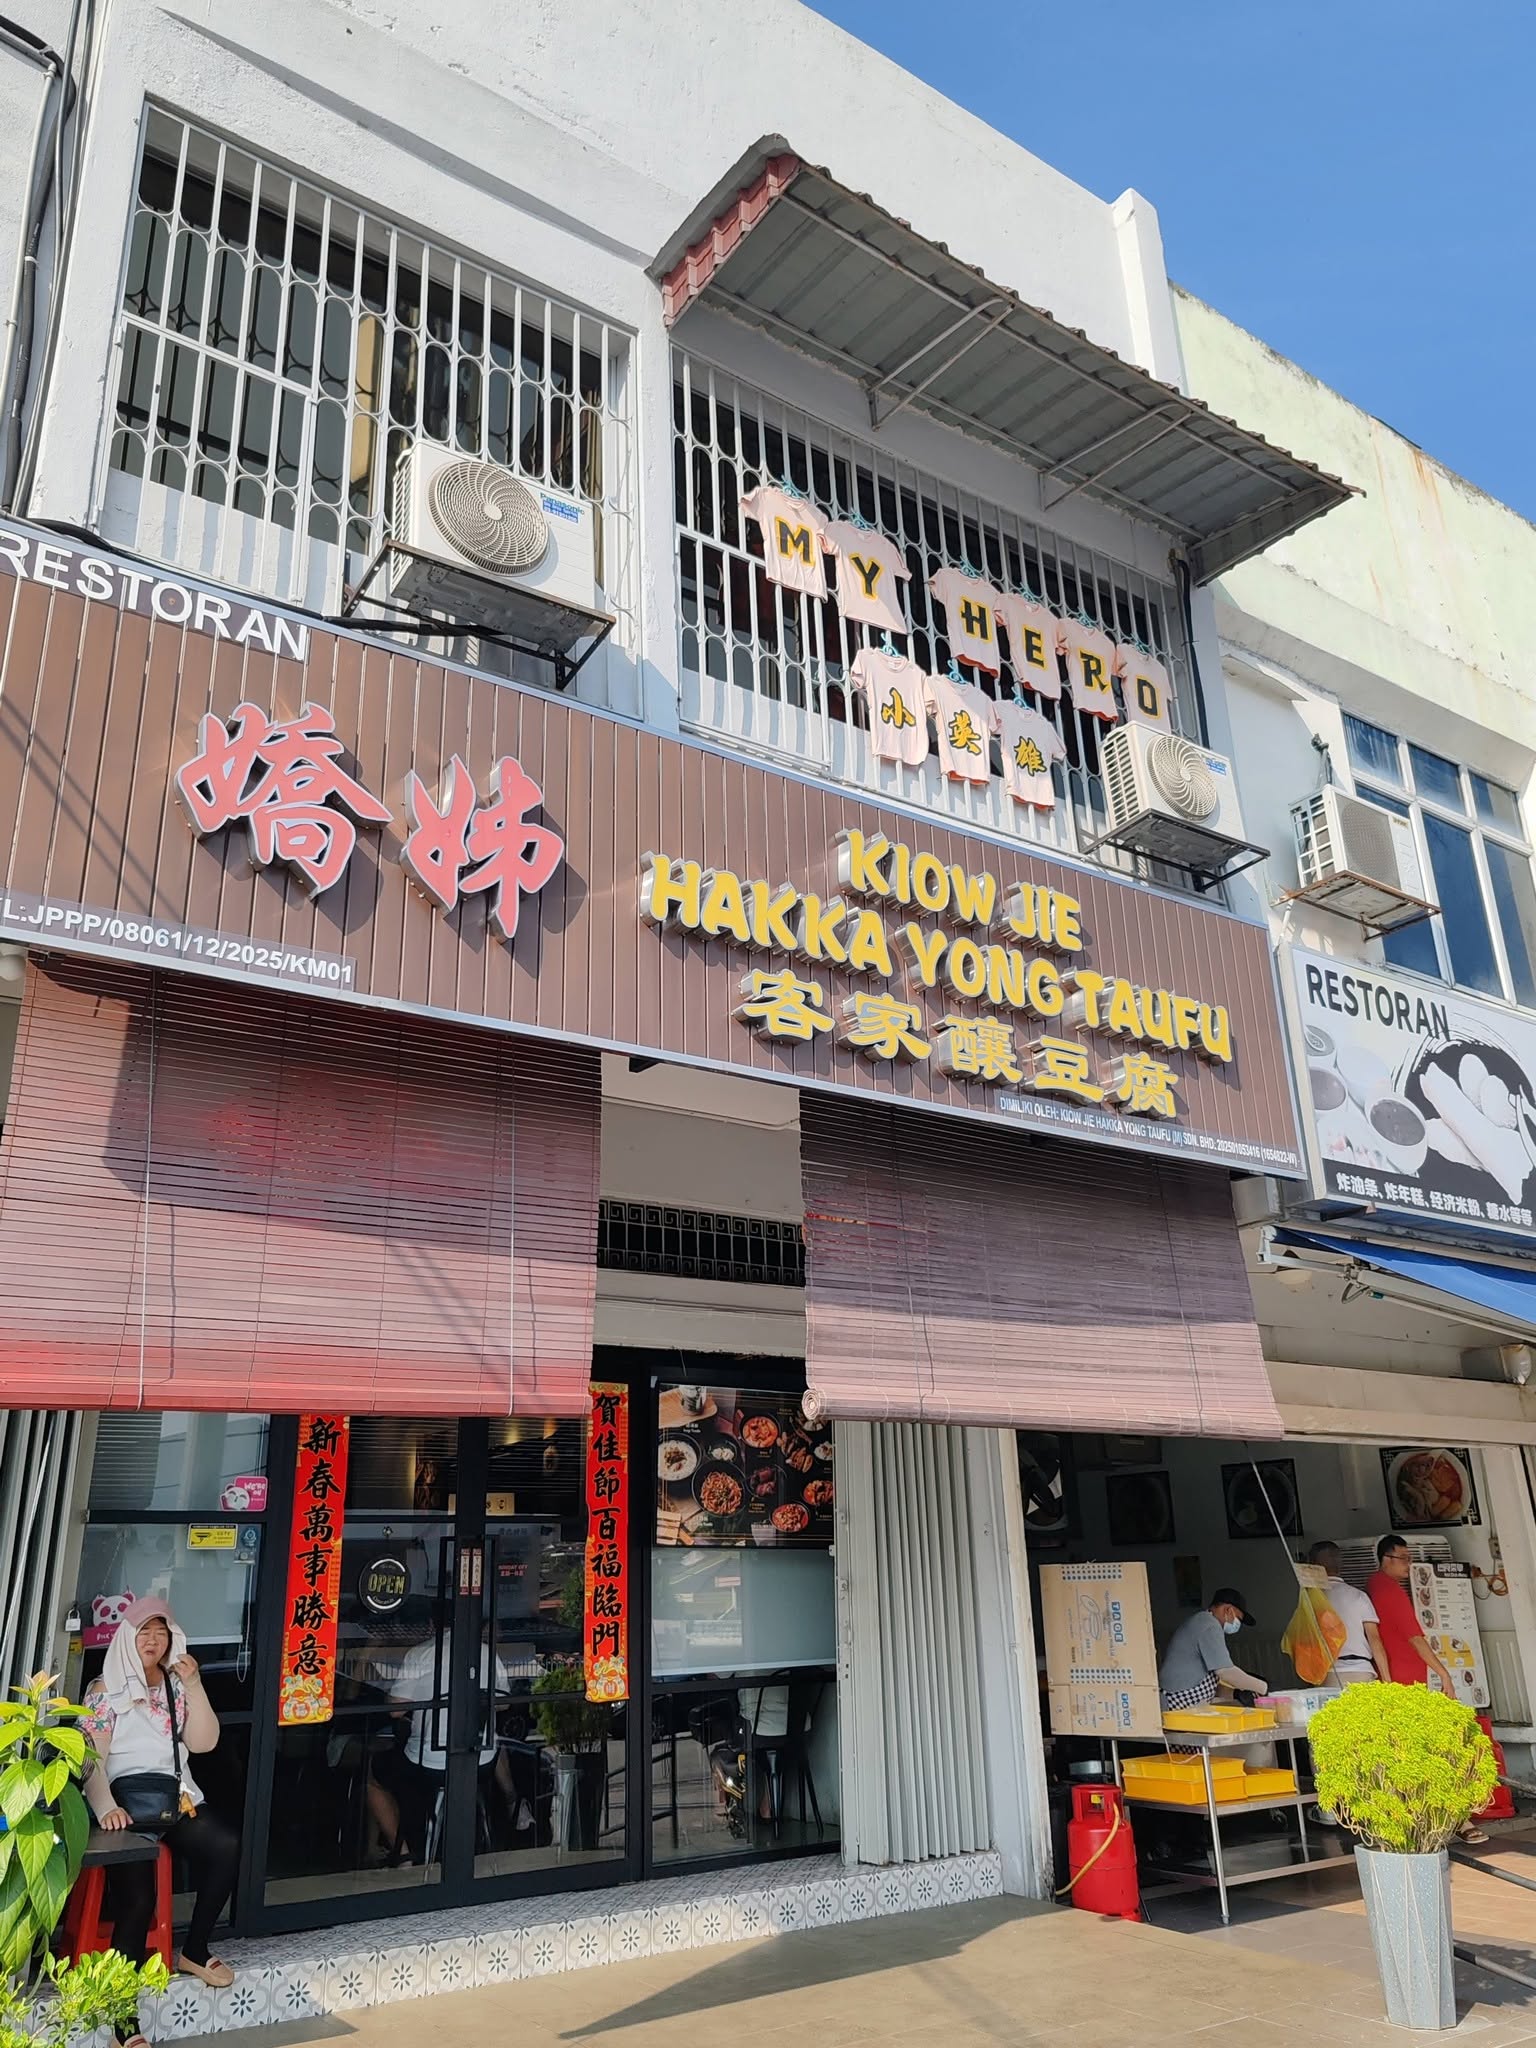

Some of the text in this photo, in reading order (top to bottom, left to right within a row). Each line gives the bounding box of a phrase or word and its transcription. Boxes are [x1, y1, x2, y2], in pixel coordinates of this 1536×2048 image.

[540, 492, 585, 515] Panasonic
[0, 528, 308, 661] RESTORAN
[881, 687, 1047, 775] 小英雄
[0, 897, 352, 984] L:JPPP/08061/12/2025/KM01
[848, 829, 1083, 951] KIOW JIE
[651, 854, 1233, 1063] HAKKA YONG TAUFU
[1305, 963, 1451, 1042] RESTORAN
[743, 969, 1179, 1119] 客家釀豆腐
[999, 1097, 1034, 1115] DIMILIKI
[1034, 1103, 1060, 1120] OLEH:
[1060, 1109, 1083, 1125] KIOW
[1083, 1114, 1095, 1128] JIE
[1095, 1116, 1124, 1133] HAKKA
[1124, 1121, 1146, 1137] YONG
[1147, 1125, 1171, 1141] TAUFU
[1183, 1135, 1200, 1147] SDN.
[288, 1416, 342, 1676] 新春萬事勝意
[590, 1390, 623, 1659] 賀佳節百福臨門
[368, 1573, 405, 1595] OPEN
